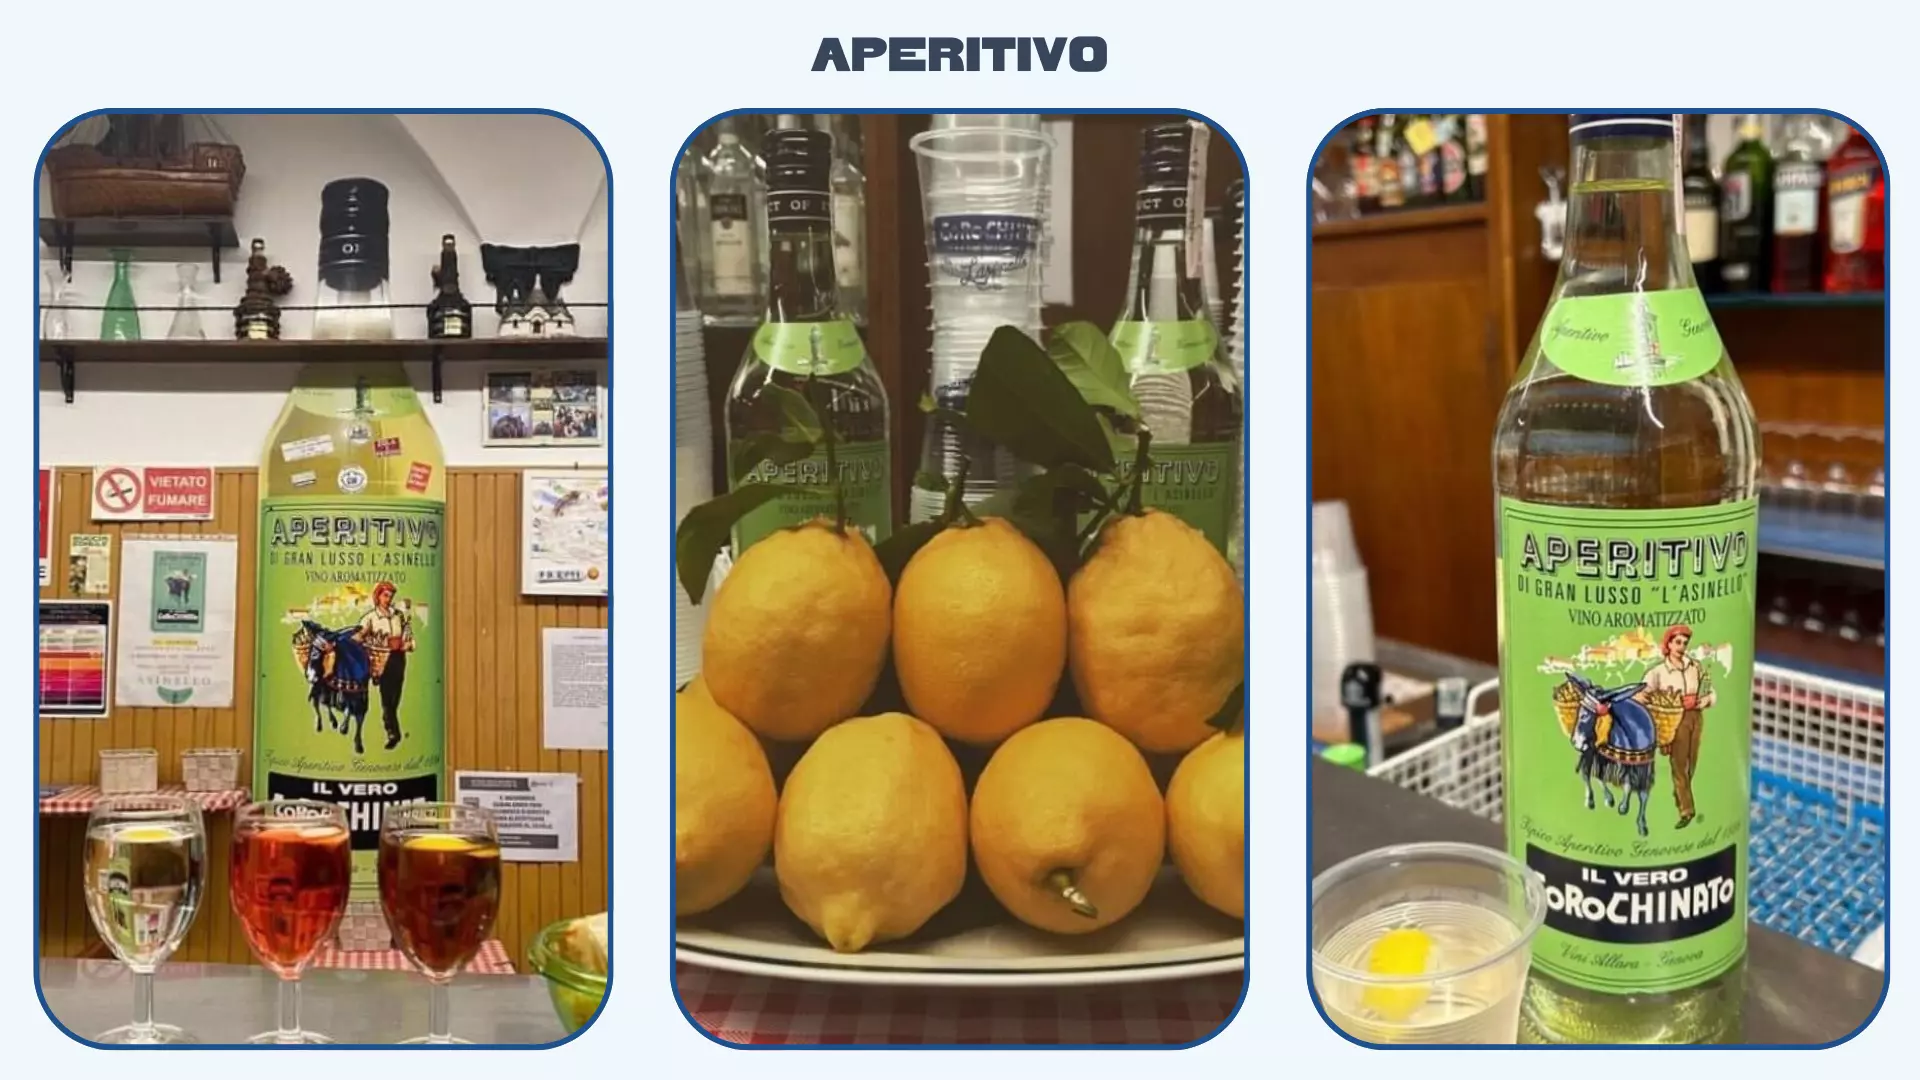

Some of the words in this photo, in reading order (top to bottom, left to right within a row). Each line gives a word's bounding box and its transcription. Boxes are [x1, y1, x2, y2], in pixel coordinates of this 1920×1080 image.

[149, 475, 208, 488] VIETATO
[148, 494, 208, 507] FUMARE
[271, 515, 440, 549] APERITIVO
[270, 550, 278, 566] DI
[285, 551, 313, 565] GRAN
[321, 551, 364, 567] LUSSO
[1520, 530, 1750, 580] APERITIVO
[305, 570, 328, 582] VINO
[331, 570, 406, 583] AROMATIZZATO
[1517, 574, 1530, 593] DI
[1535, 579, 1577, 602] GRAN
[1584, 585, 1642, 605] LUSSO
[1568, 608, 1601, 627] VINO
[1604, 607, 1706, 629] AROMATIZZATO
[313, 782, 333, 795] IL
[338, 783, 398, 796] VERO
[1555, 834, 1624, 858] Aperitivo
[1629, 840, 1695, 858] Genovese
[1582, 868, 1606, 885] IL
[1613, 868, 1688, 887] VERO
[1560, 941, 1588, 964] Vini
